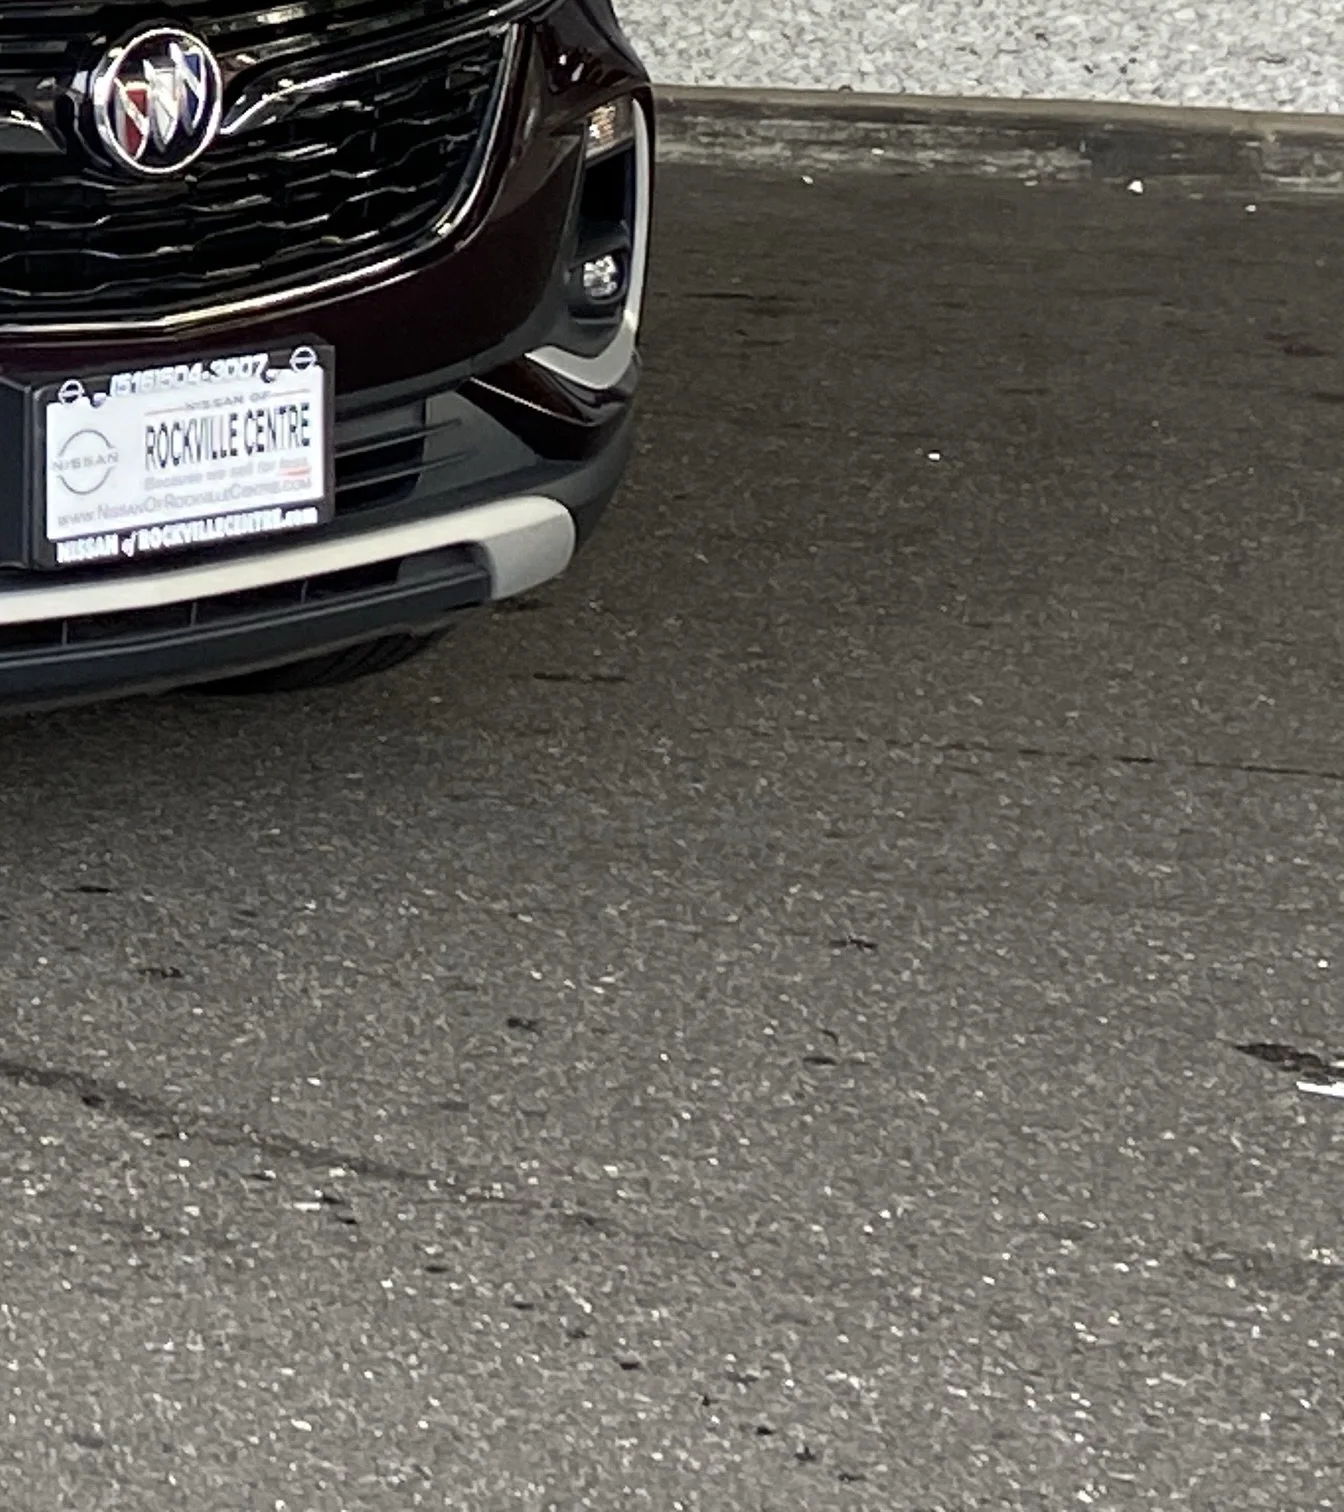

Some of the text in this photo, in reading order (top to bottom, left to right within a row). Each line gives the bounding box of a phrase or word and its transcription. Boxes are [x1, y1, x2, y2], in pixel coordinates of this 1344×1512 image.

[144, 402, 310, 471] ROCKVILLE CENTRE
[53, 452, 119, 470] NISSAN
